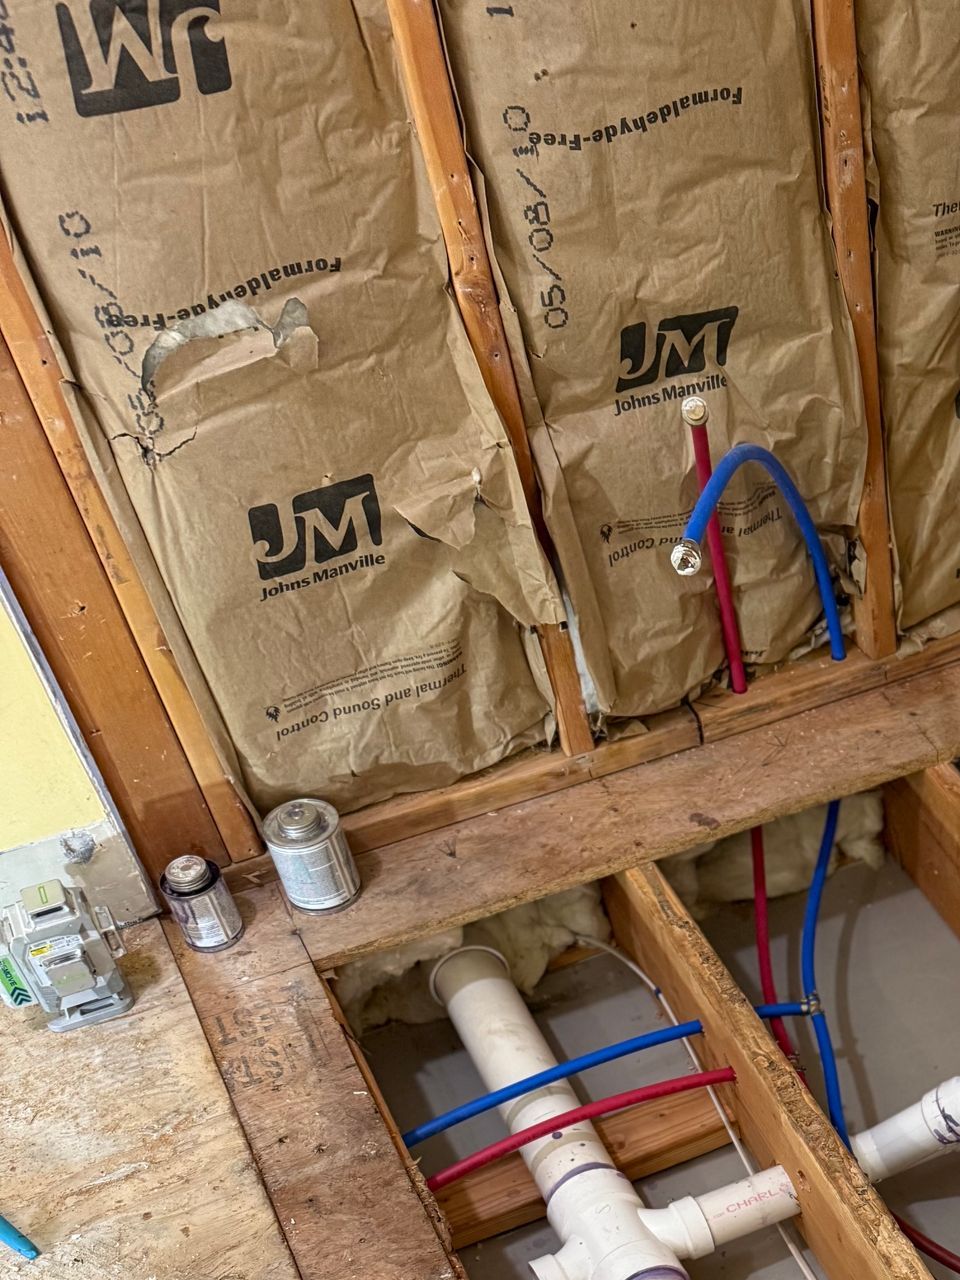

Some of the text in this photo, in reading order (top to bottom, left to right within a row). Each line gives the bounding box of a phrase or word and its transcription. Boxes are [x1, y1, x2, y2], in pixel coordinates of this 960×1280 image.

[529, 86, 743, 151] Formaldehyde-Free
[615, 305, 739, 393] JM
[614, 373, 728, 416] Johns Manville
[247, 473, 383, 581] JM
[739, 507, 783, 538] Thermal
[608, 537, 655, 568] Control
[259, 551, 386, 602] Johns Manville
[385, 685, 413, 707] and
[415, 663, 468, 700] Thermal
[333, 694, 381, 720] Sound
[276, 711, 329, 741] Control
